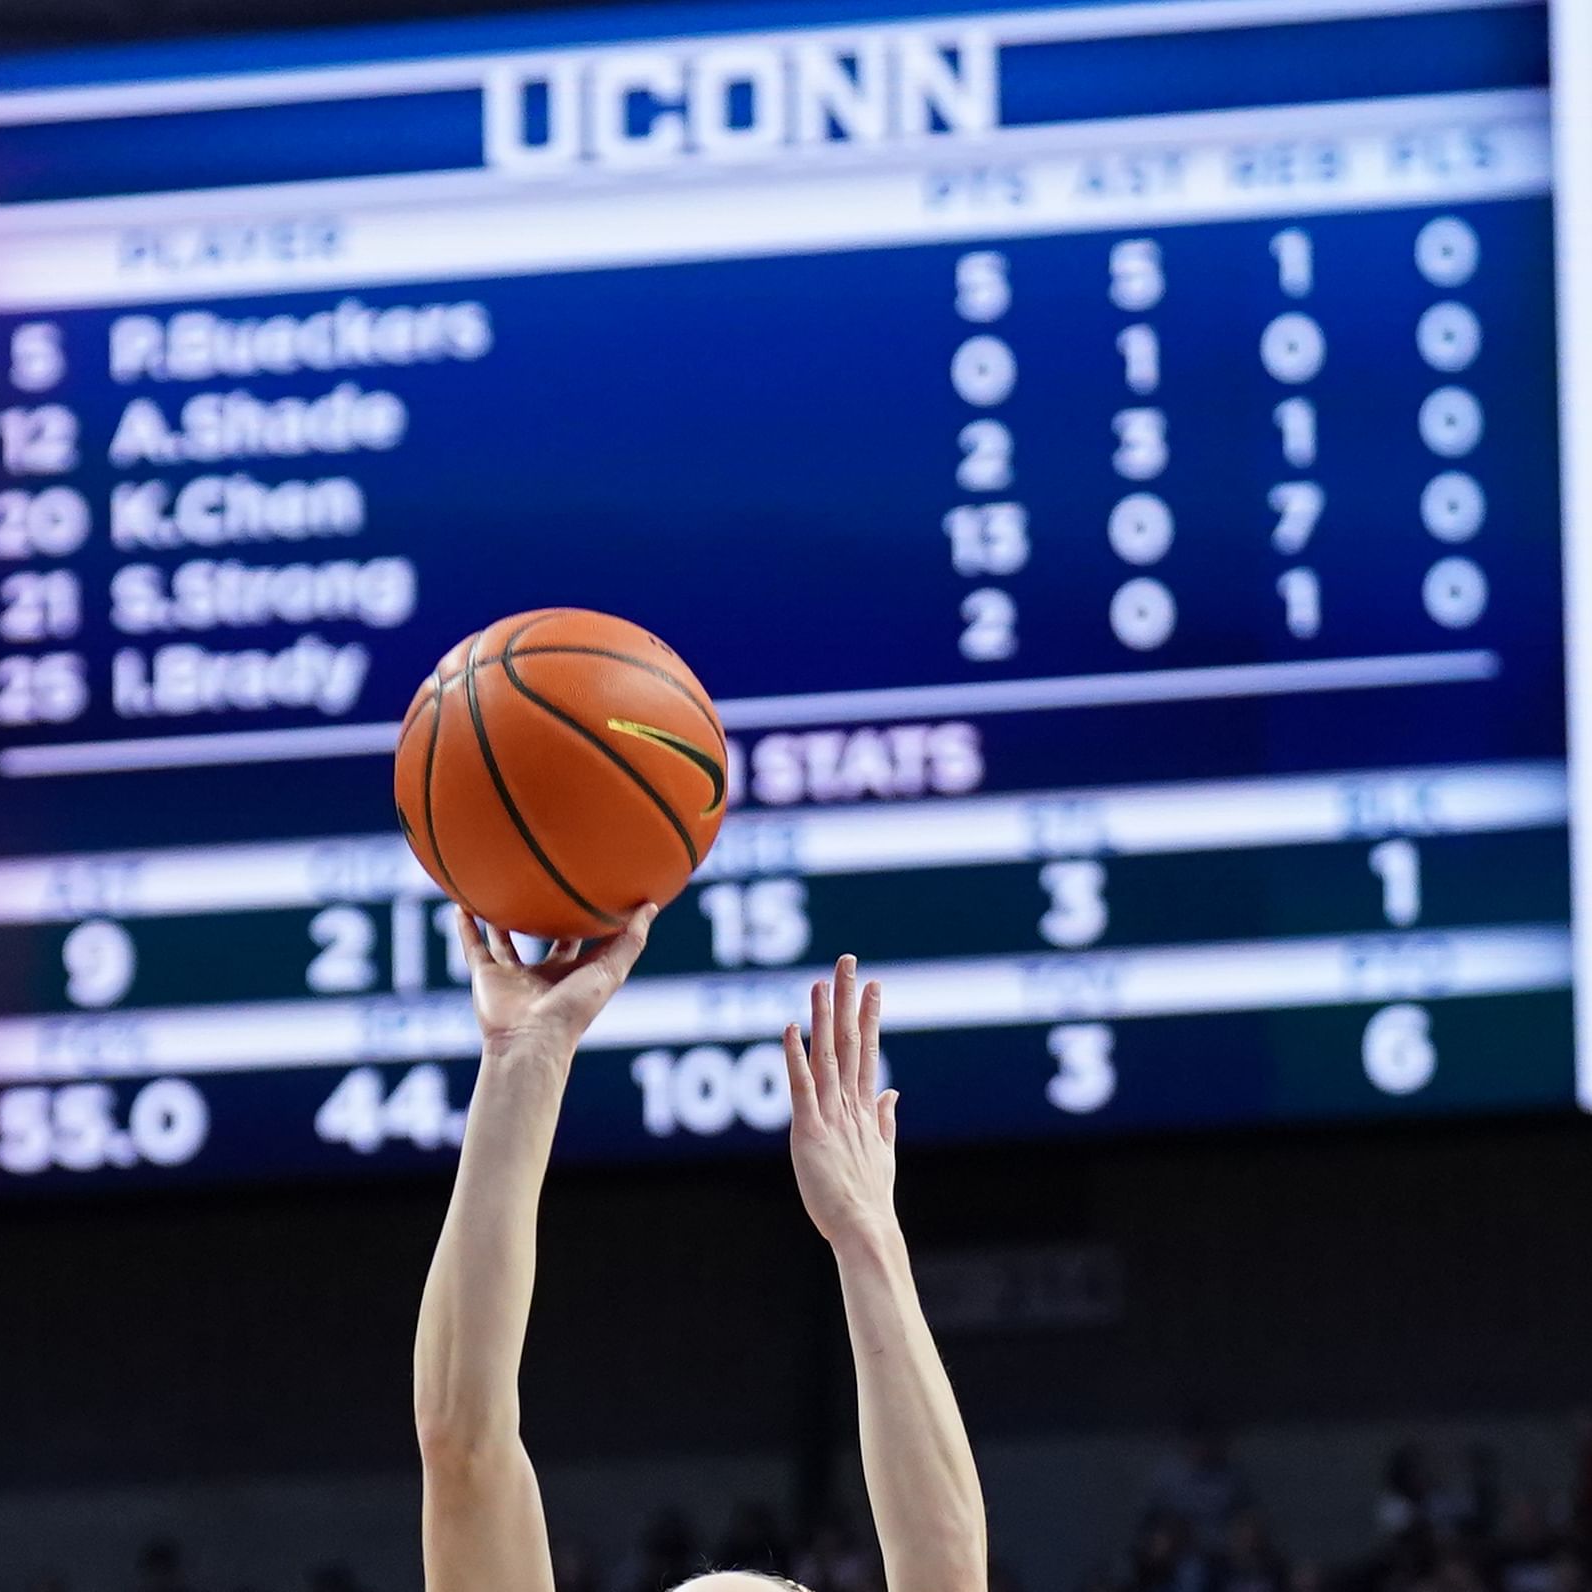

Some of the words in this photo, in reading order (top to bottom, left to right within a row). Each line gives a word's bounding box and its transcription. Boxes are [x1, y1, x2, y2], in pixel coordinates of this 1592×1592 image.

[483, 25, 999, 177] UCONN
[117, 217, 349, 271] PLAYER
[923, 163, 1027, 207] PTS
[1079, 147, 1183, 196] AST
[1231, 138, 1347, 188] REB
[10, 322, 65, 392] 5
[110, 299, 493, 383] P.Bueckers
[954, 250, 1010, 323] 5
[1110, 238, 1165, 311] 5
[1271, 227, 1314, 298] 1
[1415, 215, 1480, 287] 0
[110, 384, 407, 468] A.Shade
[951, 335, 1017, 406] 0
[1117, 324, 1160, 393] 1
[1261, 312, 1326, 383] 0
[1417, 301, 1482, 371] 0
[110, 473, 366, 549] K.Chen
[956, 419, 1014, 492] 2
[1111, 406, 1169, 480] 3
[1273, 397, 1317, 468] 1
[1418, 385, 1484, 458] 0
[110, 555, 414, 634] S.Strong
[1109, 492, 1175, 565] 0
[1267, 481, 1325, 554] 7
[1420, 470, 1486, 544] 0
[112, 634, 371, 716] I.Brady
[959, 587, 1018, 661] 2
[1110, 577, 1177, 650] 0
[1276, 566, 1321, 639] 1
[1422, 556, 1488, 629] 0
[751, 721, 986, 806] STATS
[63, 919, 136, 1007] 9
[699, 880, 809, 967] 15
[1037, 860, 1109, 948] 3
[1368, 839, 1422, 927] 1
[315, 1064, 466, 1153] 44.
[1046, 1022, 1116, 1113] 3
[1362, 1003, 1437, 1094] 6
